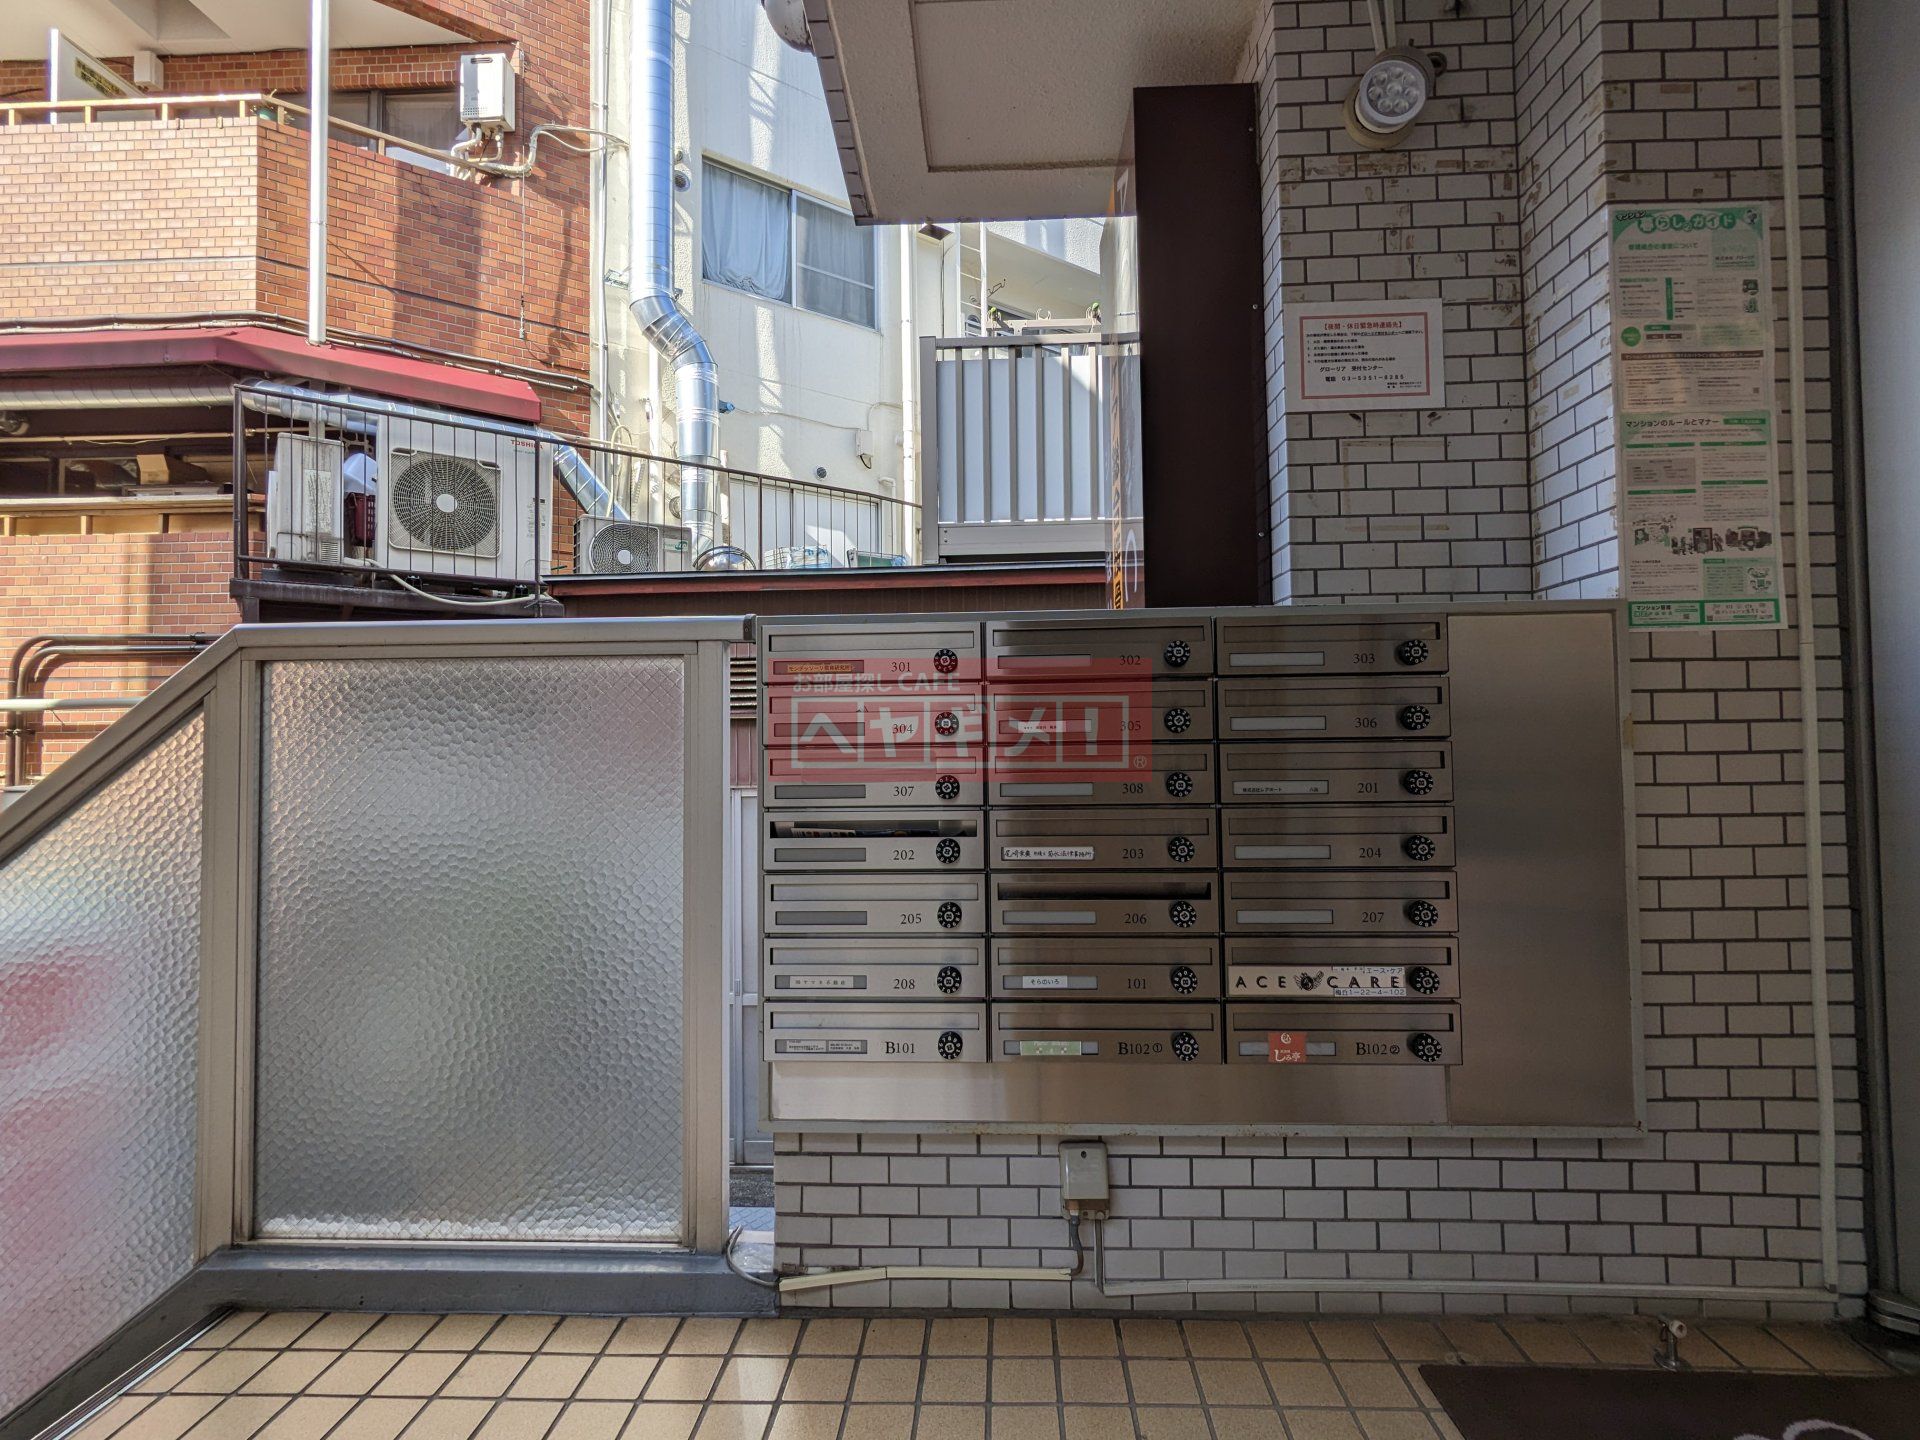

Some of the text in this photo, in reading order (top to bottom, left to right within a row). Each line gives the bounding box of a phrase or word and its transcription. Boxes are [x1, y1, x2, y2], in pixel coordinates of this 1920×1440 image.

[1625, 418, 1720, 428] マンションのルールとマナー
[511, 440, 543, 448] TOSHIA
[1119, 654, 1141, 666] 302
[1353, 653, 1376, 665] 303
[890, 661, 911, 673] 301
[892, 723, 914, 735] 304
[1120, 719, 1142, 732] 305
[1355, 717, 1378, 729] 306
[893, 785, 915, 797] 307
[1122, 783, 1144, 795] 308
[1357, 782, 1379, 794] 201
[893, 849, 915, 861] 202
[1122, 848, 1144, 860] 203
[1359, 847, 1382, 859] 204
[900, 913, 922, 925] 205
[1124, 913, 1147, 925] 206
[1361, 911, 1385, 923] 207
[893, 978, 915, 990] 208
[1031, 978, 1060, 986] そらのいろ
[1126, 978, 1147, 990] 101
[1235, 976, 1400, 989] ACE CARE
[885, 1041, 915, 1054] B101
